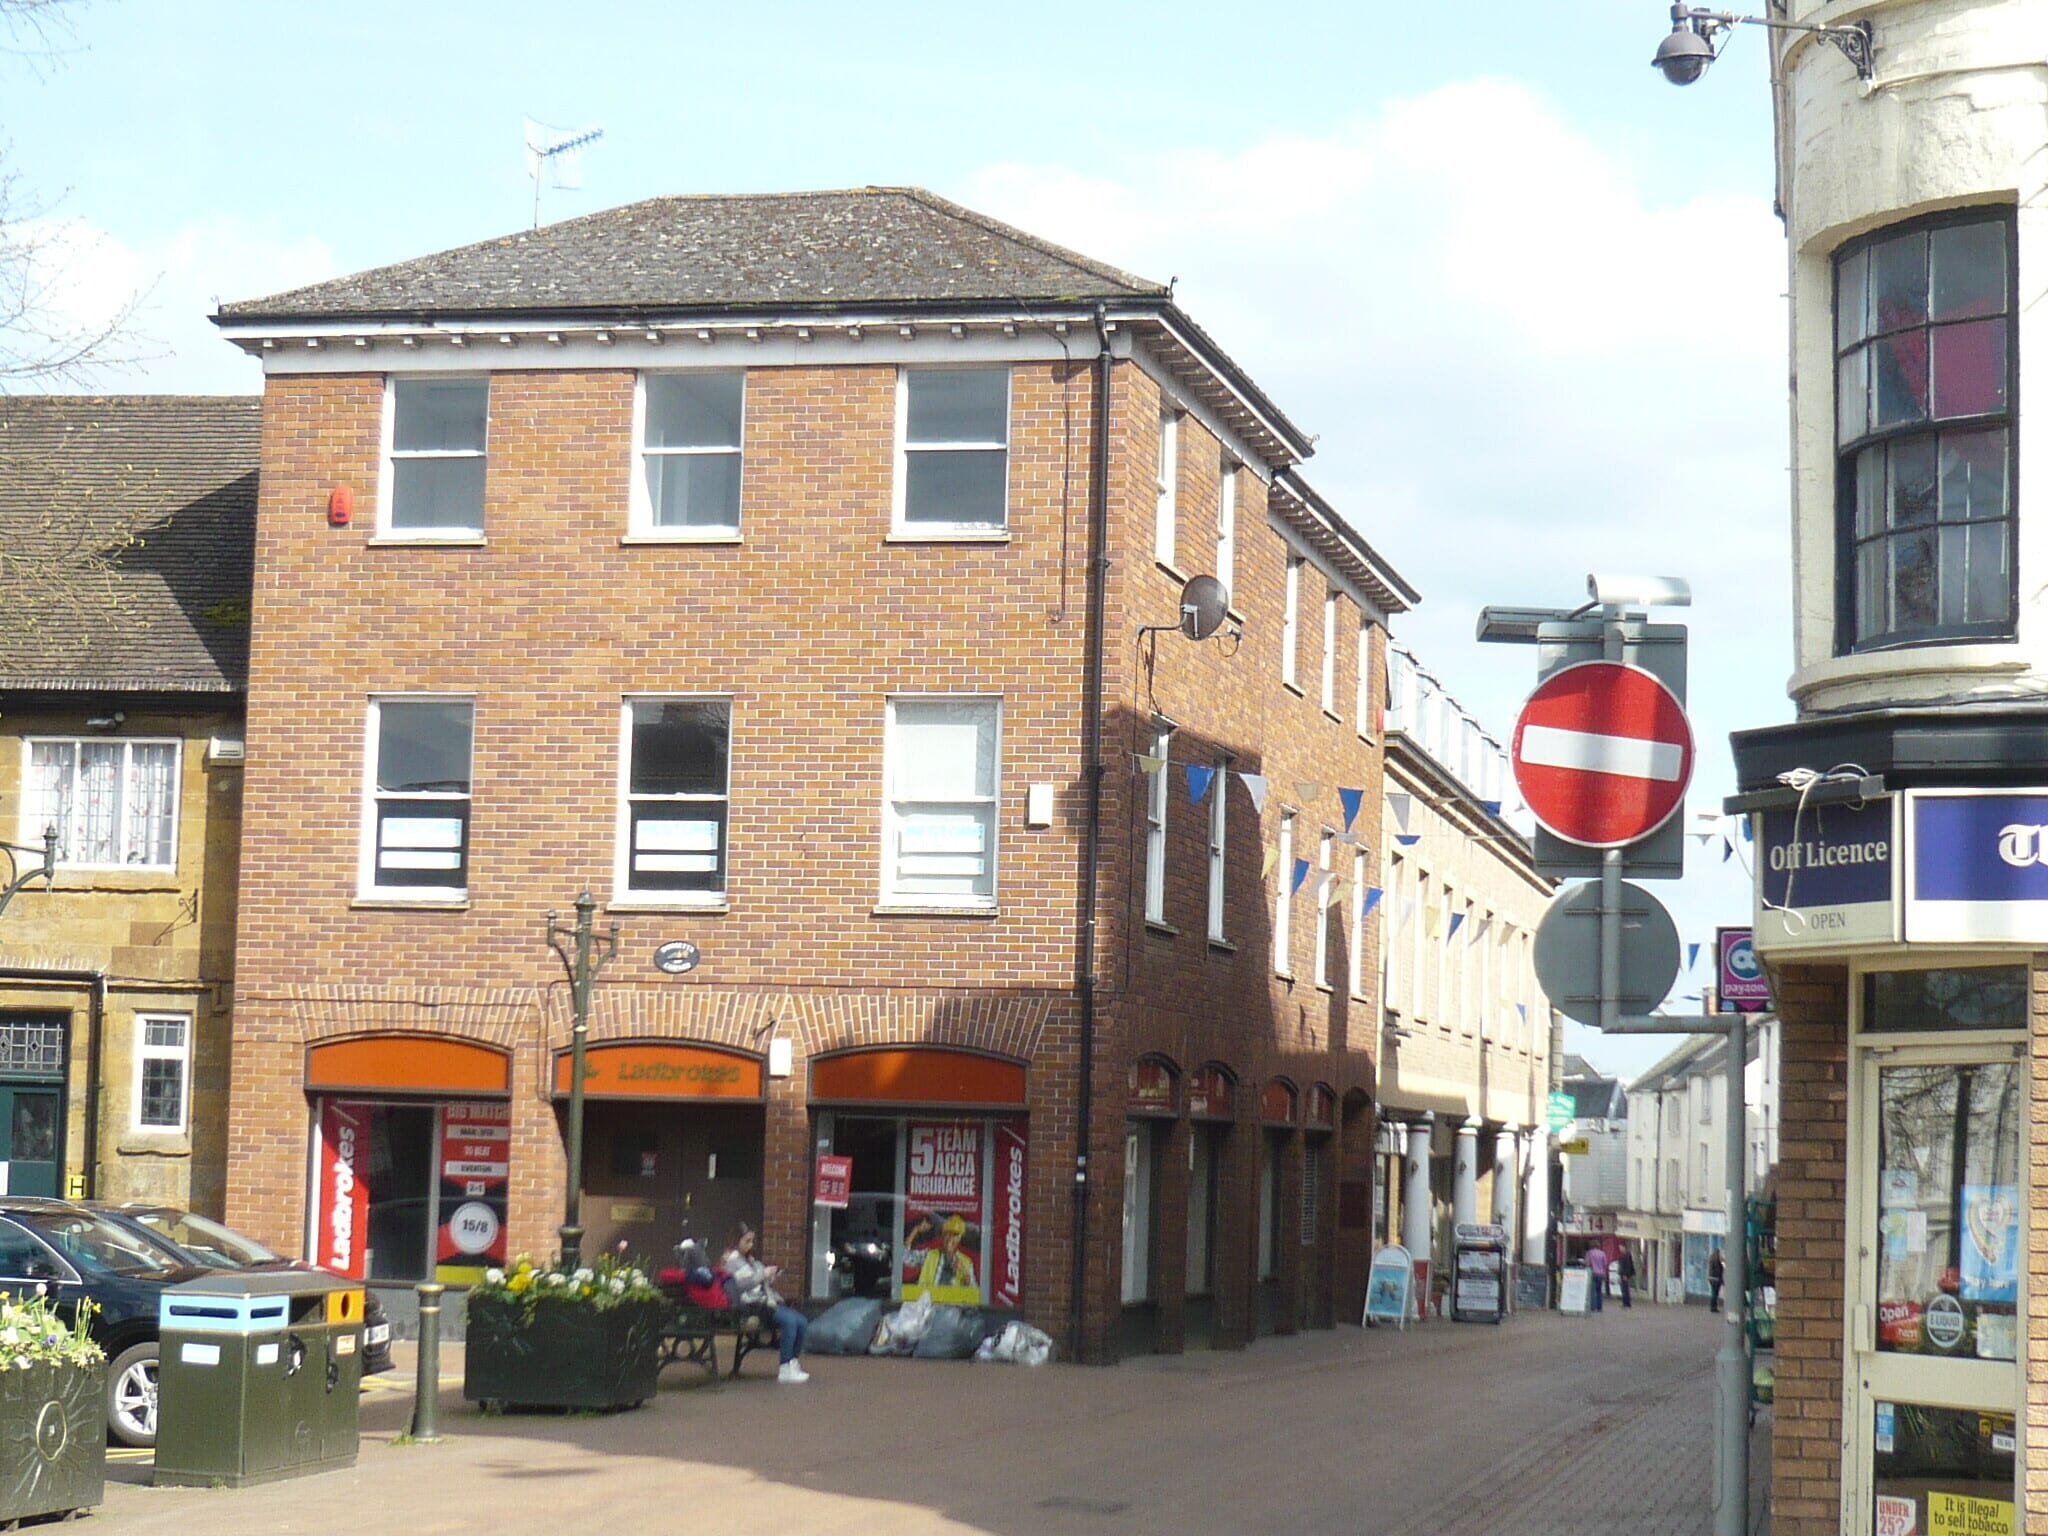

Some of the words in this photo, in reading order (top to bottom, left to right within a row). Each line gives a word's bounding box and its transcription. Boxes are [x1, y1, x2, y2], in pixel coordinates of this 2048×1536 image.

[1770, 842, 1800, 871] Off
[1806, 839, 1887, 867] Licence
[1811, 912, 1846, 930] OPEN
[910, 1127, 935, 1175] 5
[936, 1128, 977, 1153] TEAM
[934, 1152, 976, 1176] ACCA
[70, 1177, 84, 1196] H
[910, 1175, 976, 1196] INSURANCE
[331, 1126, 356, 1270] Ladbrokes
[462, 1219, 488, 1234] 15/8
[1005, 1146, 1024, 1295] Ladbrokes
[1880, 1305, 1909, 1324] Open
[1879, 1500, 1910, 1518] UNDER
[1945, 1497, 1954, 1513] It
[1957, 1500, 1965, 1513] is
[1968, 1500, 1999, 1520] illegal
[1879, 1516, 1905, 1536] 25?
[1934, 1511, 1945, 1526] to
[1948, 1512, 1965, 1528] sell
[1968, 1515, 2009, 1535] tobacco
